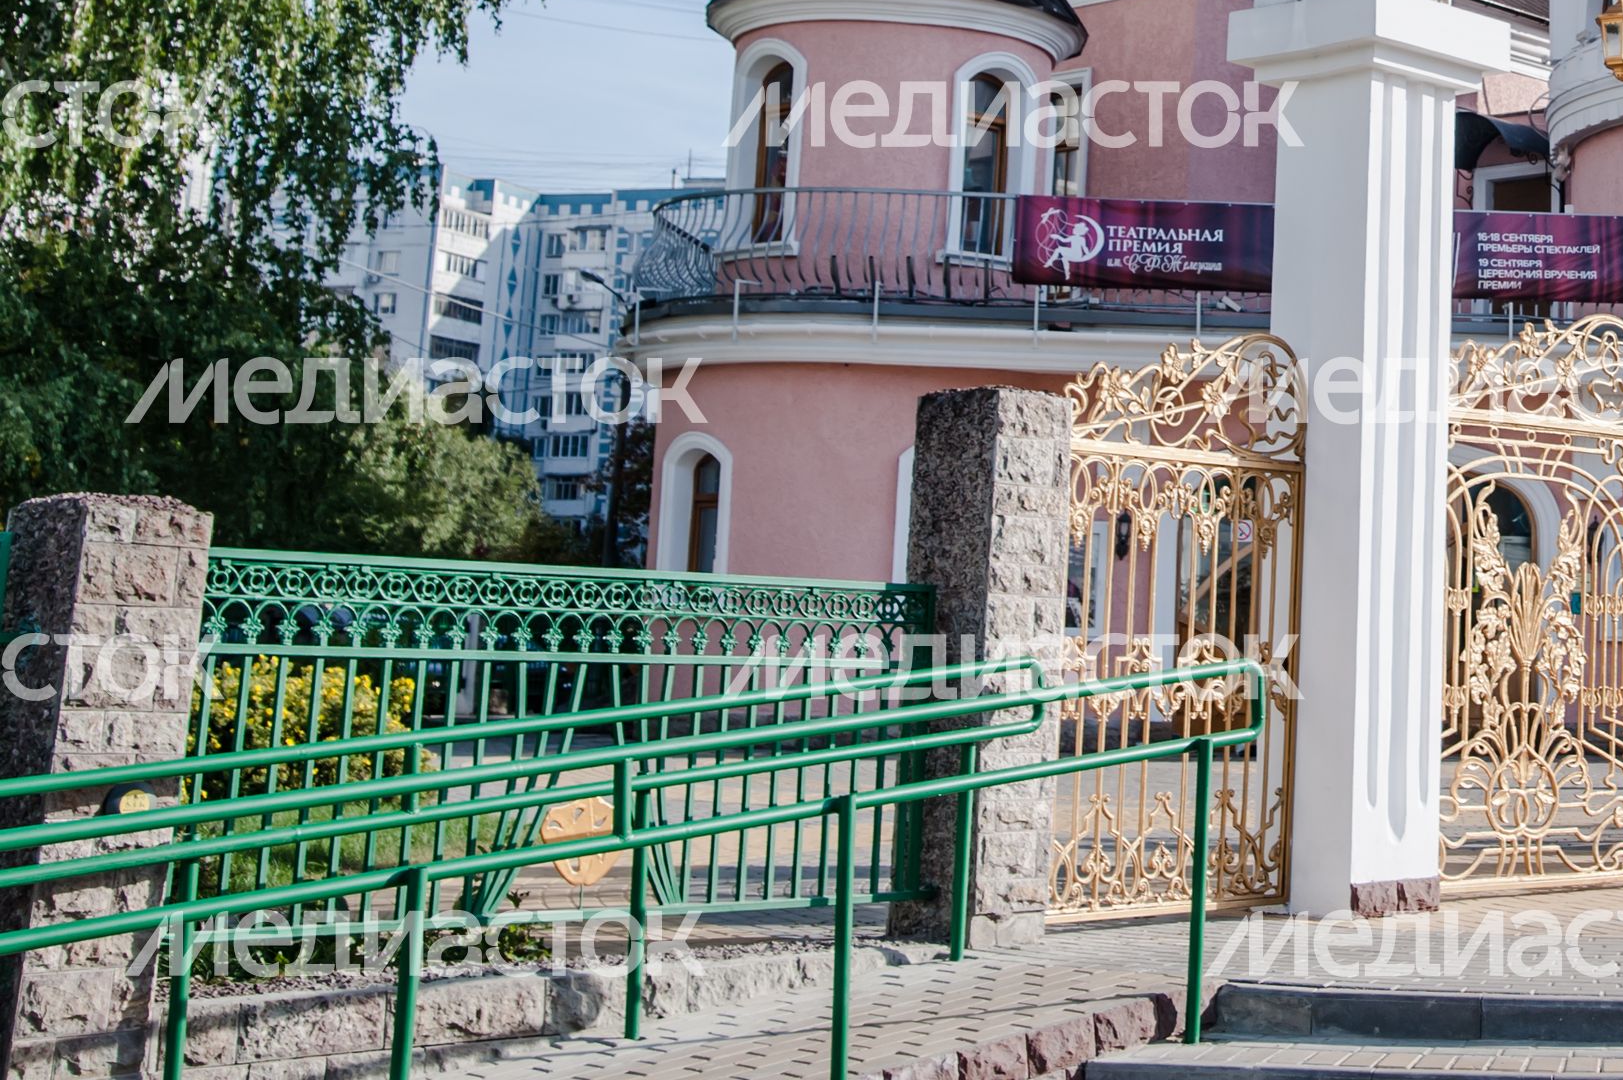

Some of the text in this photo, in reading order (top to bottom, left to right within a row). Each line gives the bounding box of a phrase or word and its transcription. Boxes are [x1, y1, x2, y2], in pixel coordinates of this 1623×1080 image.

[1106, 225, 1224, 242] ТЕАТРАЛЬНАЯ
[1477, 232, 1554, 244] 16-18 СЕНТЯБРЯ
[1108, 239, 1184, 254] ПРЕМИЯ
[1477, 243, 1600, 254] ПРЕМЬЕРЫ СПЕКТАКЛЕЙ
[1478, 258, 1543, 268] 19 СЕНТЯБРЯ
[1478, 269, 1598, 280] ЦЕРЕМОНИЯ ВРУЧЕНИЯ
[1477, 280, 1522, 290] ПРЕМИИ
